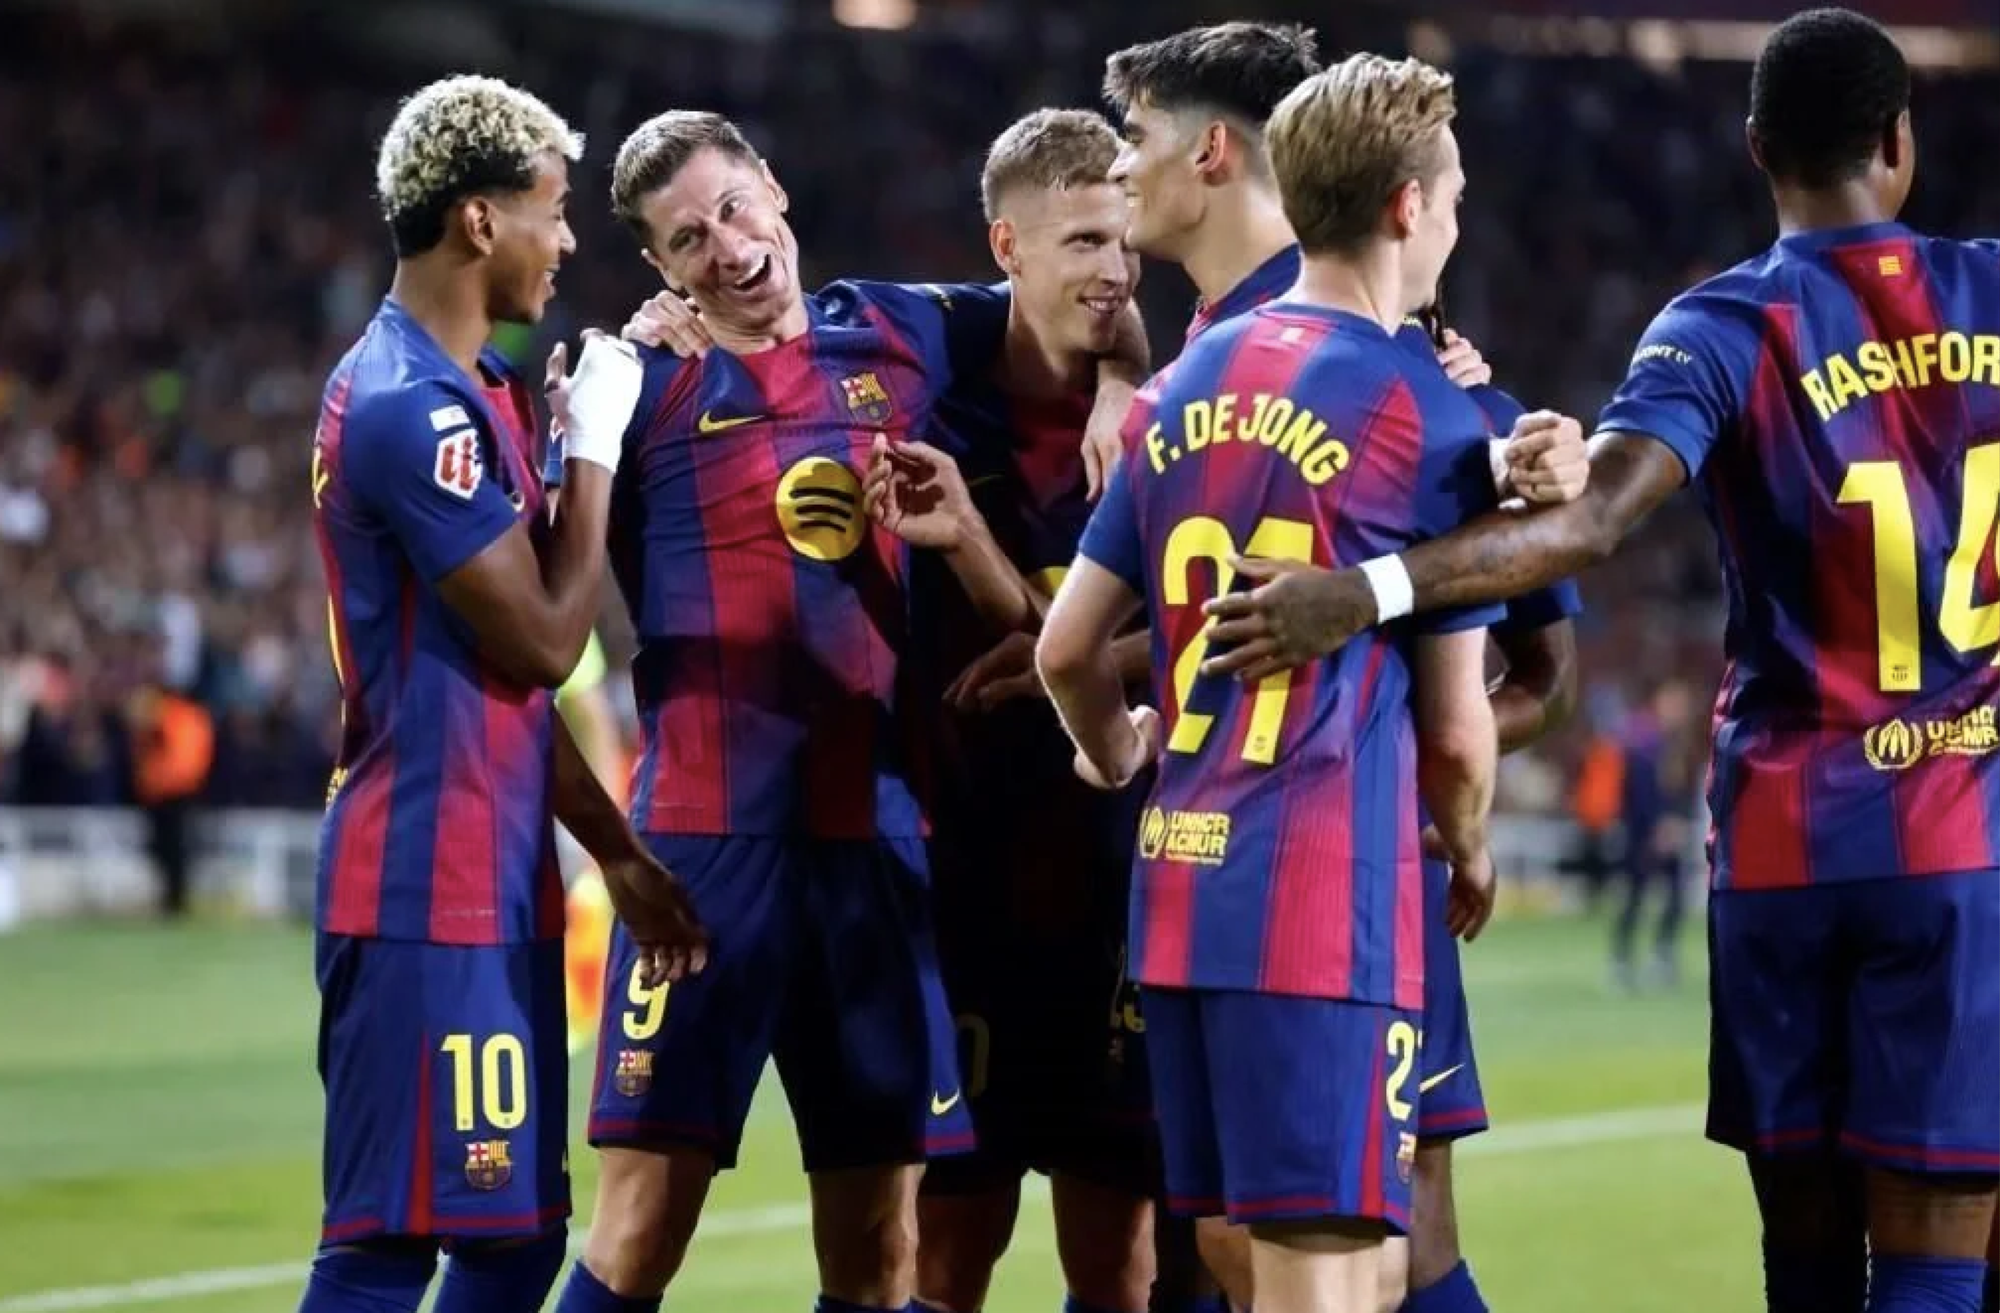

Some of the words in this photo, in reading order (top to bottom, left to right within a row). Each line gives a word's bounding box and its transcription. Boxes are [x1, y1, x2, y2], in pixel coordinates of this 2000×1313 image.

[1146, 421, 1181, 475] F.
[1185, 395, 1238, 452] DE
[1237, 394, 1350, 485] JONG
[1163, 516, 1313, 764] 21
[441, 1033, 527, 1131] 10
[1386, 1020, 1422, 1122] 2
